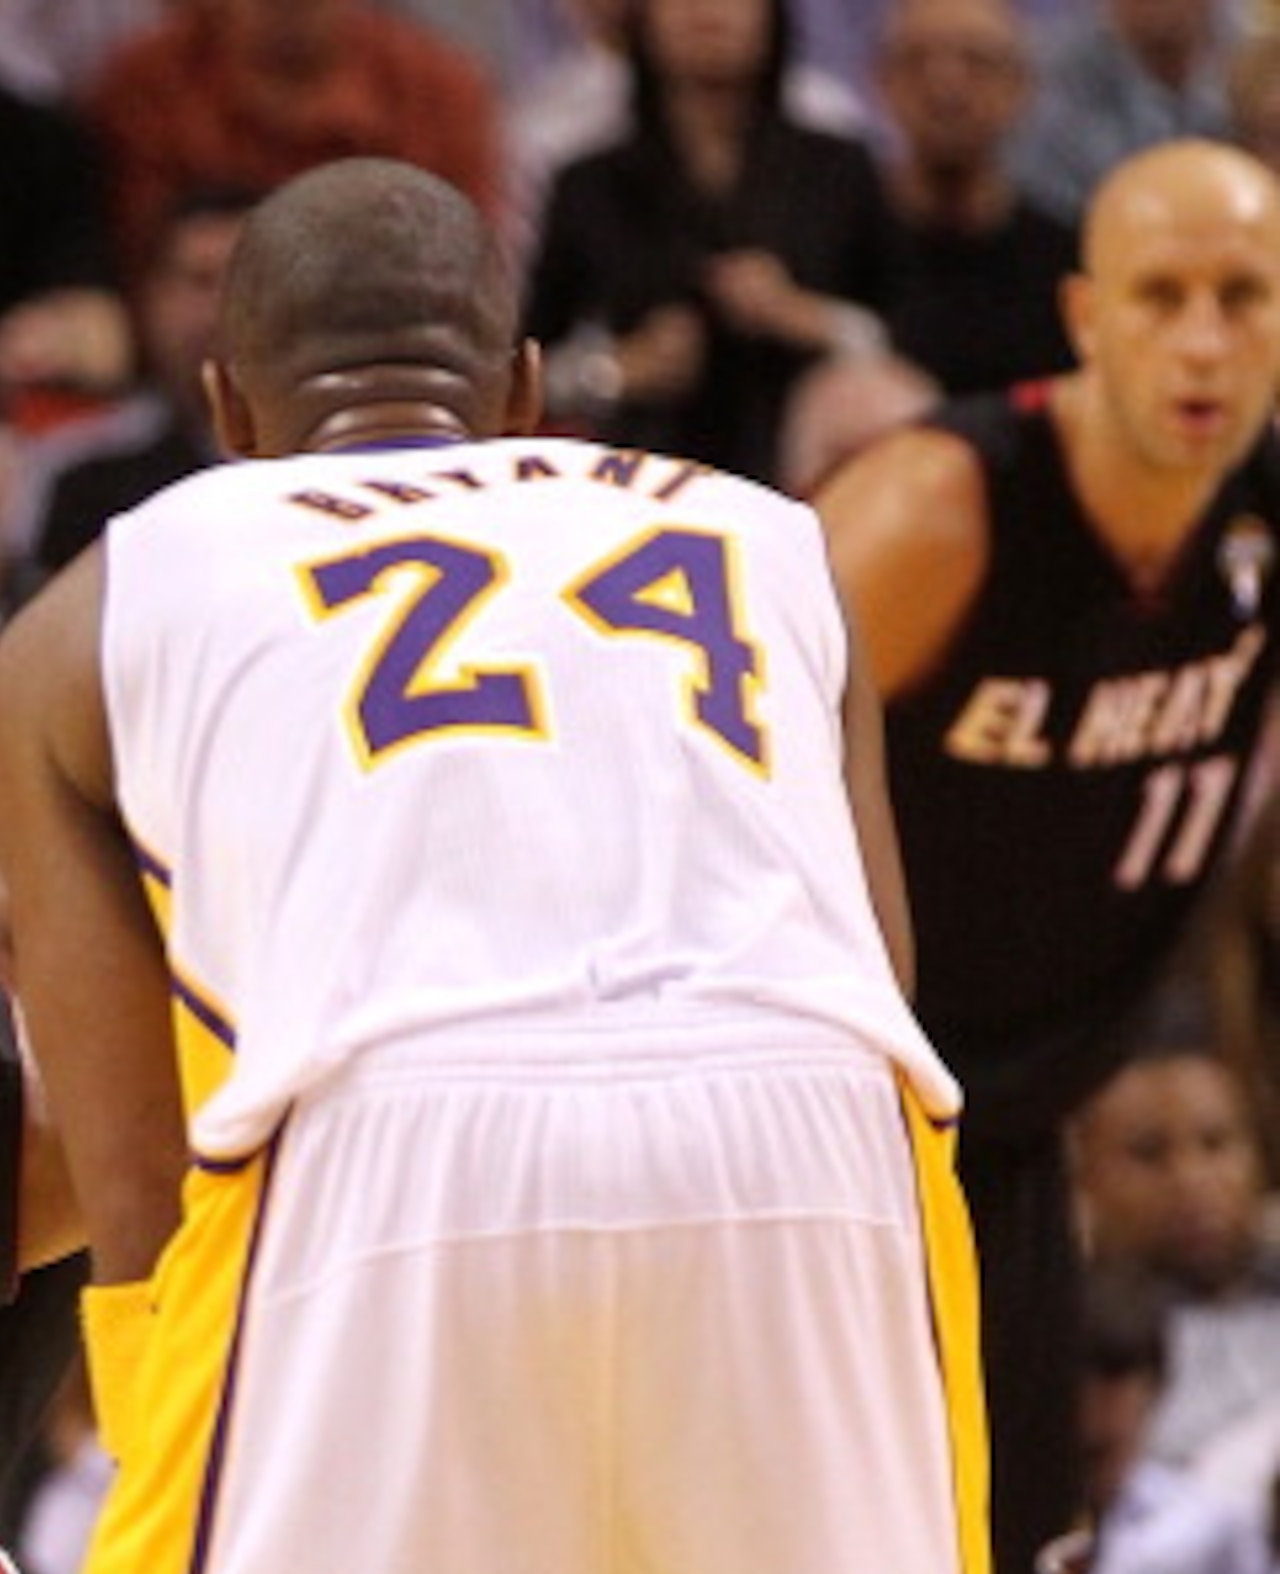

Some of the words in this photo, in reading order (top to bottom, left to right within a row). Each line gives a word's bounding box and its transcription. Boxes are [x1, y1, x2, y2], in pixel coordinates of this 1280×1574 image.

[291, 522, 771, 780] 24
[944, 676, 1052, 769] EL
[1113, 754, 1237, 882] 11
